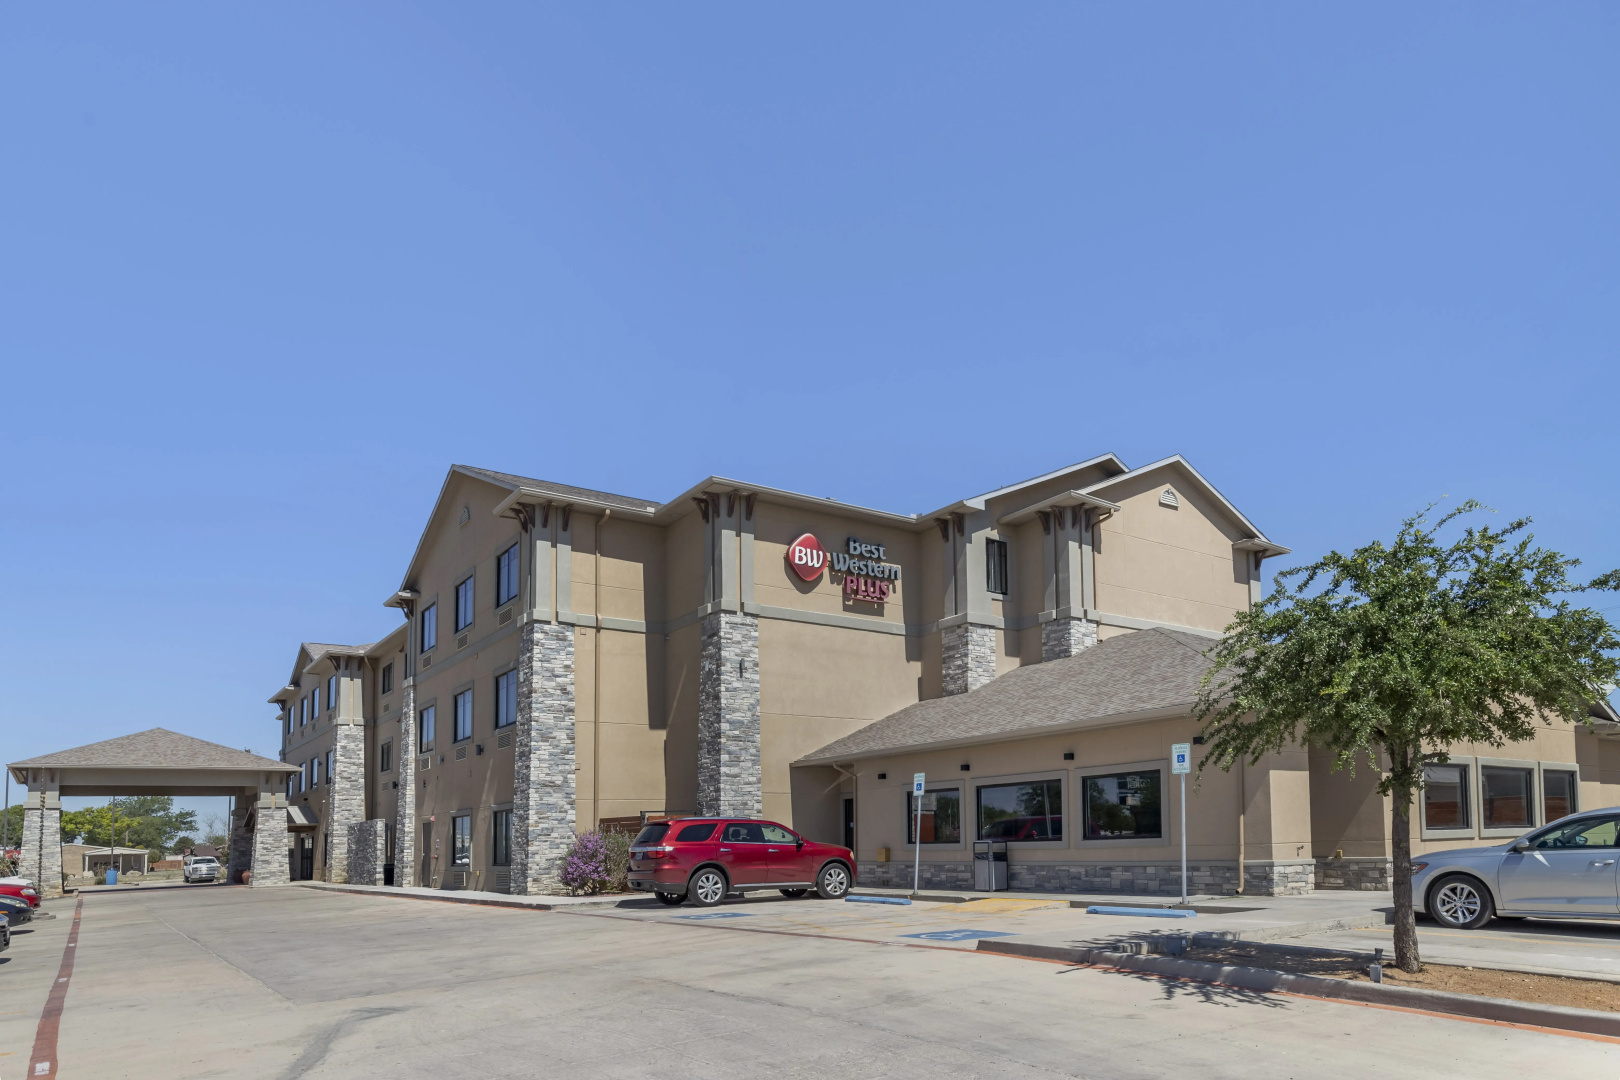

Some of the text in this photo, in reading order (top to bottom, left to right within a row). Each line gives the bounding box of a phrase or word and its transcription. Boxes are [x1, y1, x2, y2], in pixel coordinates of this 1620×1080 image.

[794, 546, 823, 568] BW
[848, 536, 886, 559] Best
[832, 552, 900, 580] Western
[844, 576, 889, 599] PLUS
